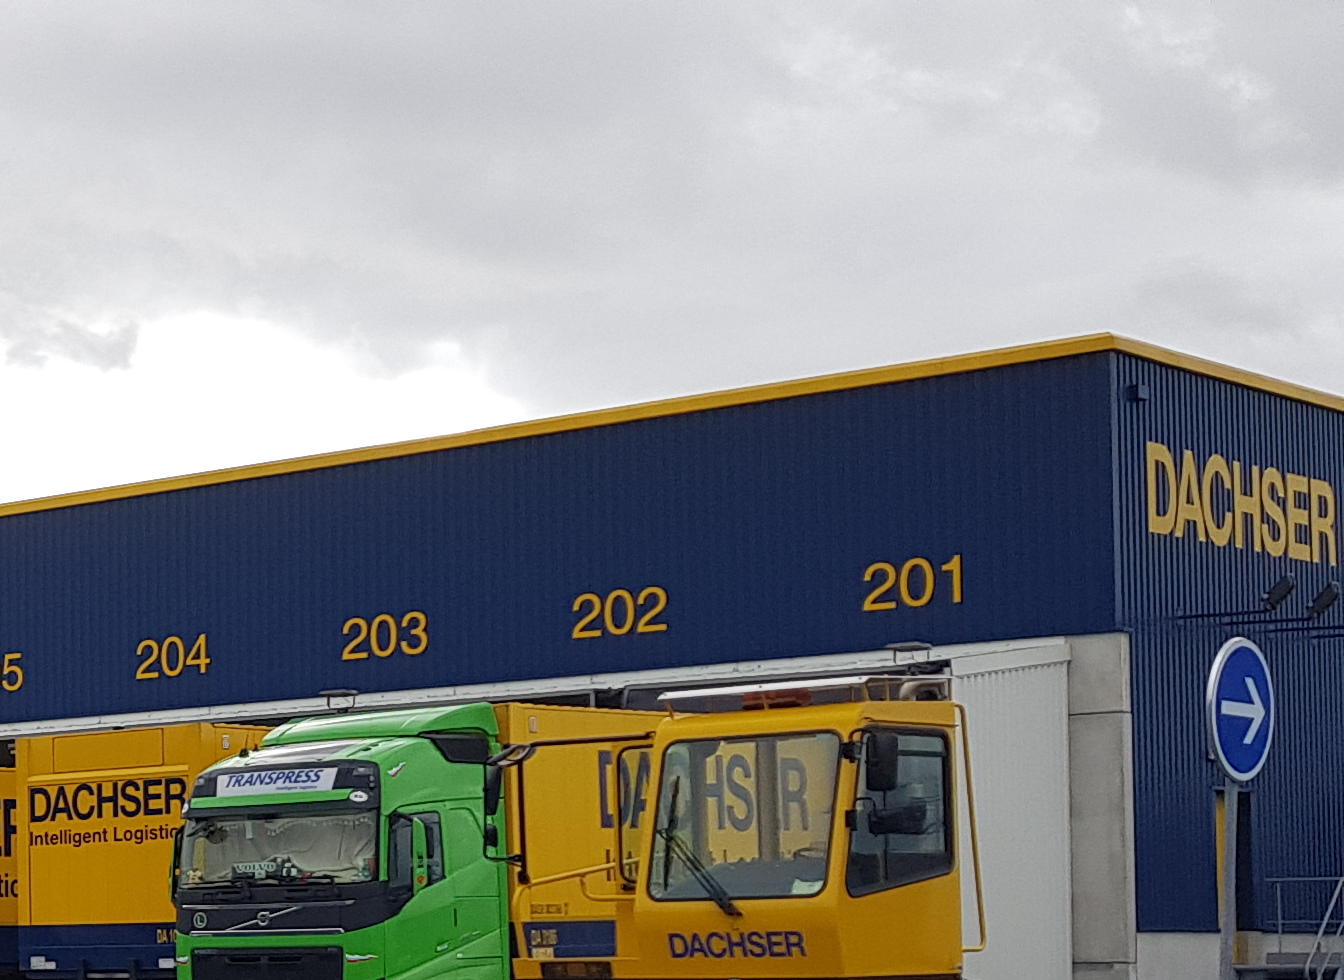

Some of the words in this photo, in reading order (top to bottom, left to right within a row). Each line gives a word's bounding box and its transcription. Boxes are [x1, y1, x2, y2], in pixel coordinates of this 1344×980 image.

[1146, 440, 1337, 566] DACHSER
[862, 554, 963, 612] 201
[571, 586, 669, 639] 202
[135, 633, 212, 680] 204
[341, 611, 429, 661] 203
[30, 777, 187, 823] DACHSER
[225, 769, 324, 789] TRANSPRESS
[29, 828, 109, 848] Intelligent
[235, 862, 275, 873] VOLVO
[156, 929, 168, 943] DA
[667, 930, 807, 959] DACHSER
